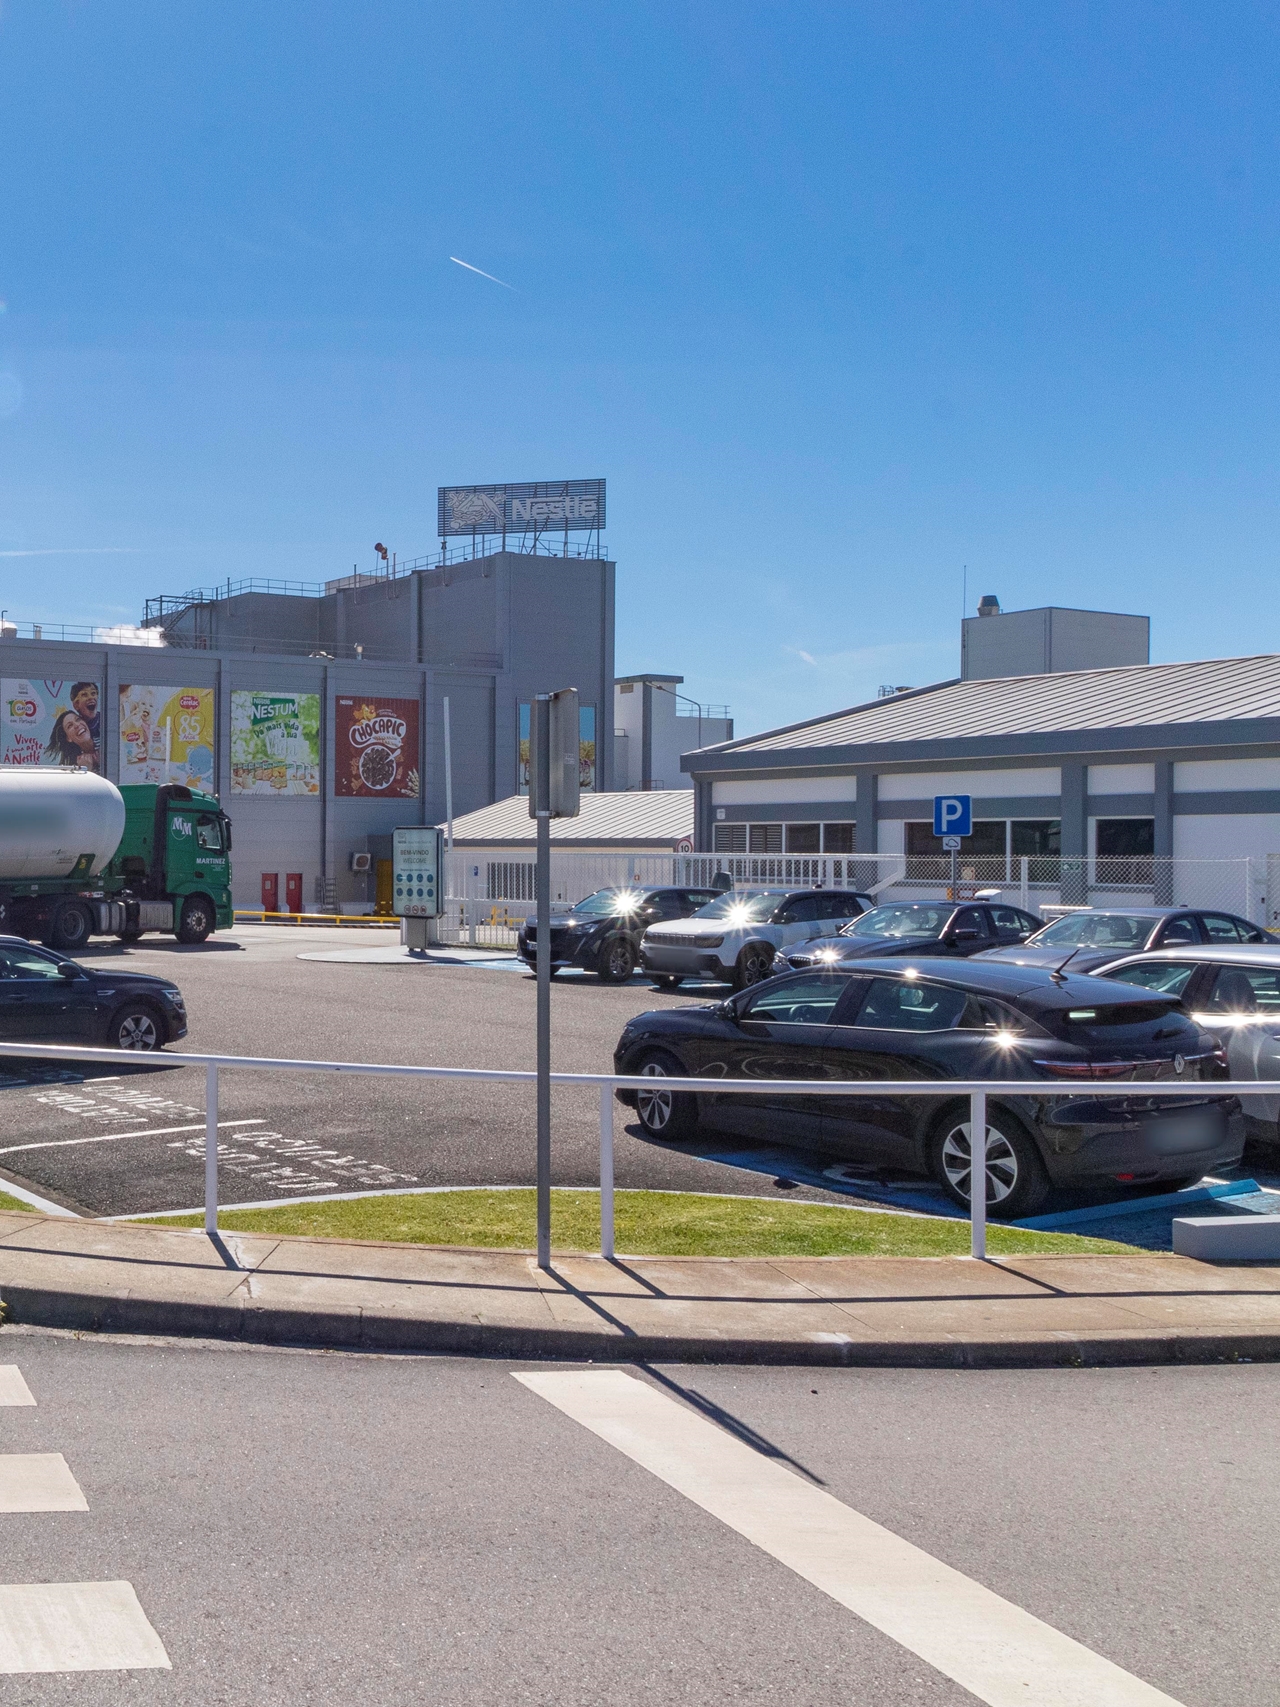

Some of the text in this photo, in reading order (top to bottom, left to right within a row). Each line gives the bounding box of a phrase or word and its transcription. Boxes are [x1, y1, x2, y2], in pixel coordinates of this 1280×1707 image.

[251, 702, 298, 719] NESTUM
[179, 714, 200, 736] 85
[265, 720, 282, 732] mais
[350, 718, 405, 746] CHOCAPIC
[941, 799, 963, 832] P
[681, 845, 690, 853] 10
[195, 857, 226, 865] MARTINEZ
